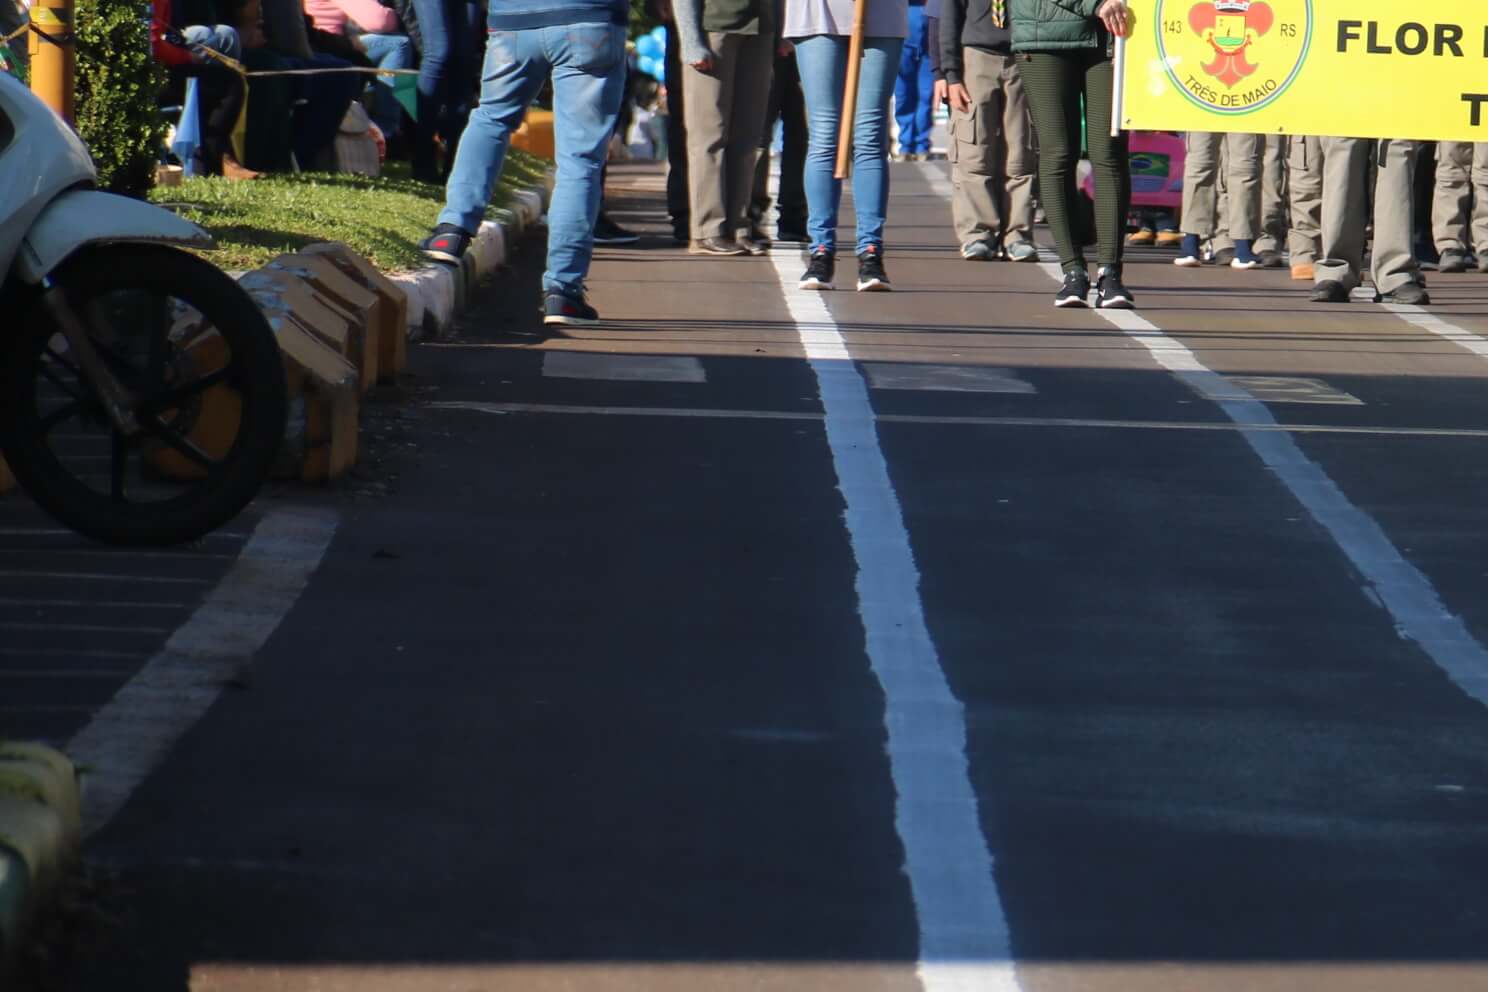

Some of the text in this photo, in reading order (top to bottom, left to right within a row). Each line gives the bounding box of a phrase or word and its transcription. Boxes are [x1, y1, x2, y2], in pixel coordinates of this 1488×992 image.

[1163, 20, 1182, 34] 143
[1280, 23, 1297, 38] RS
[1336, 20, 1464, 57] FLOR
[1184, 74, 1277, 107] TRÊS DE MAIO
